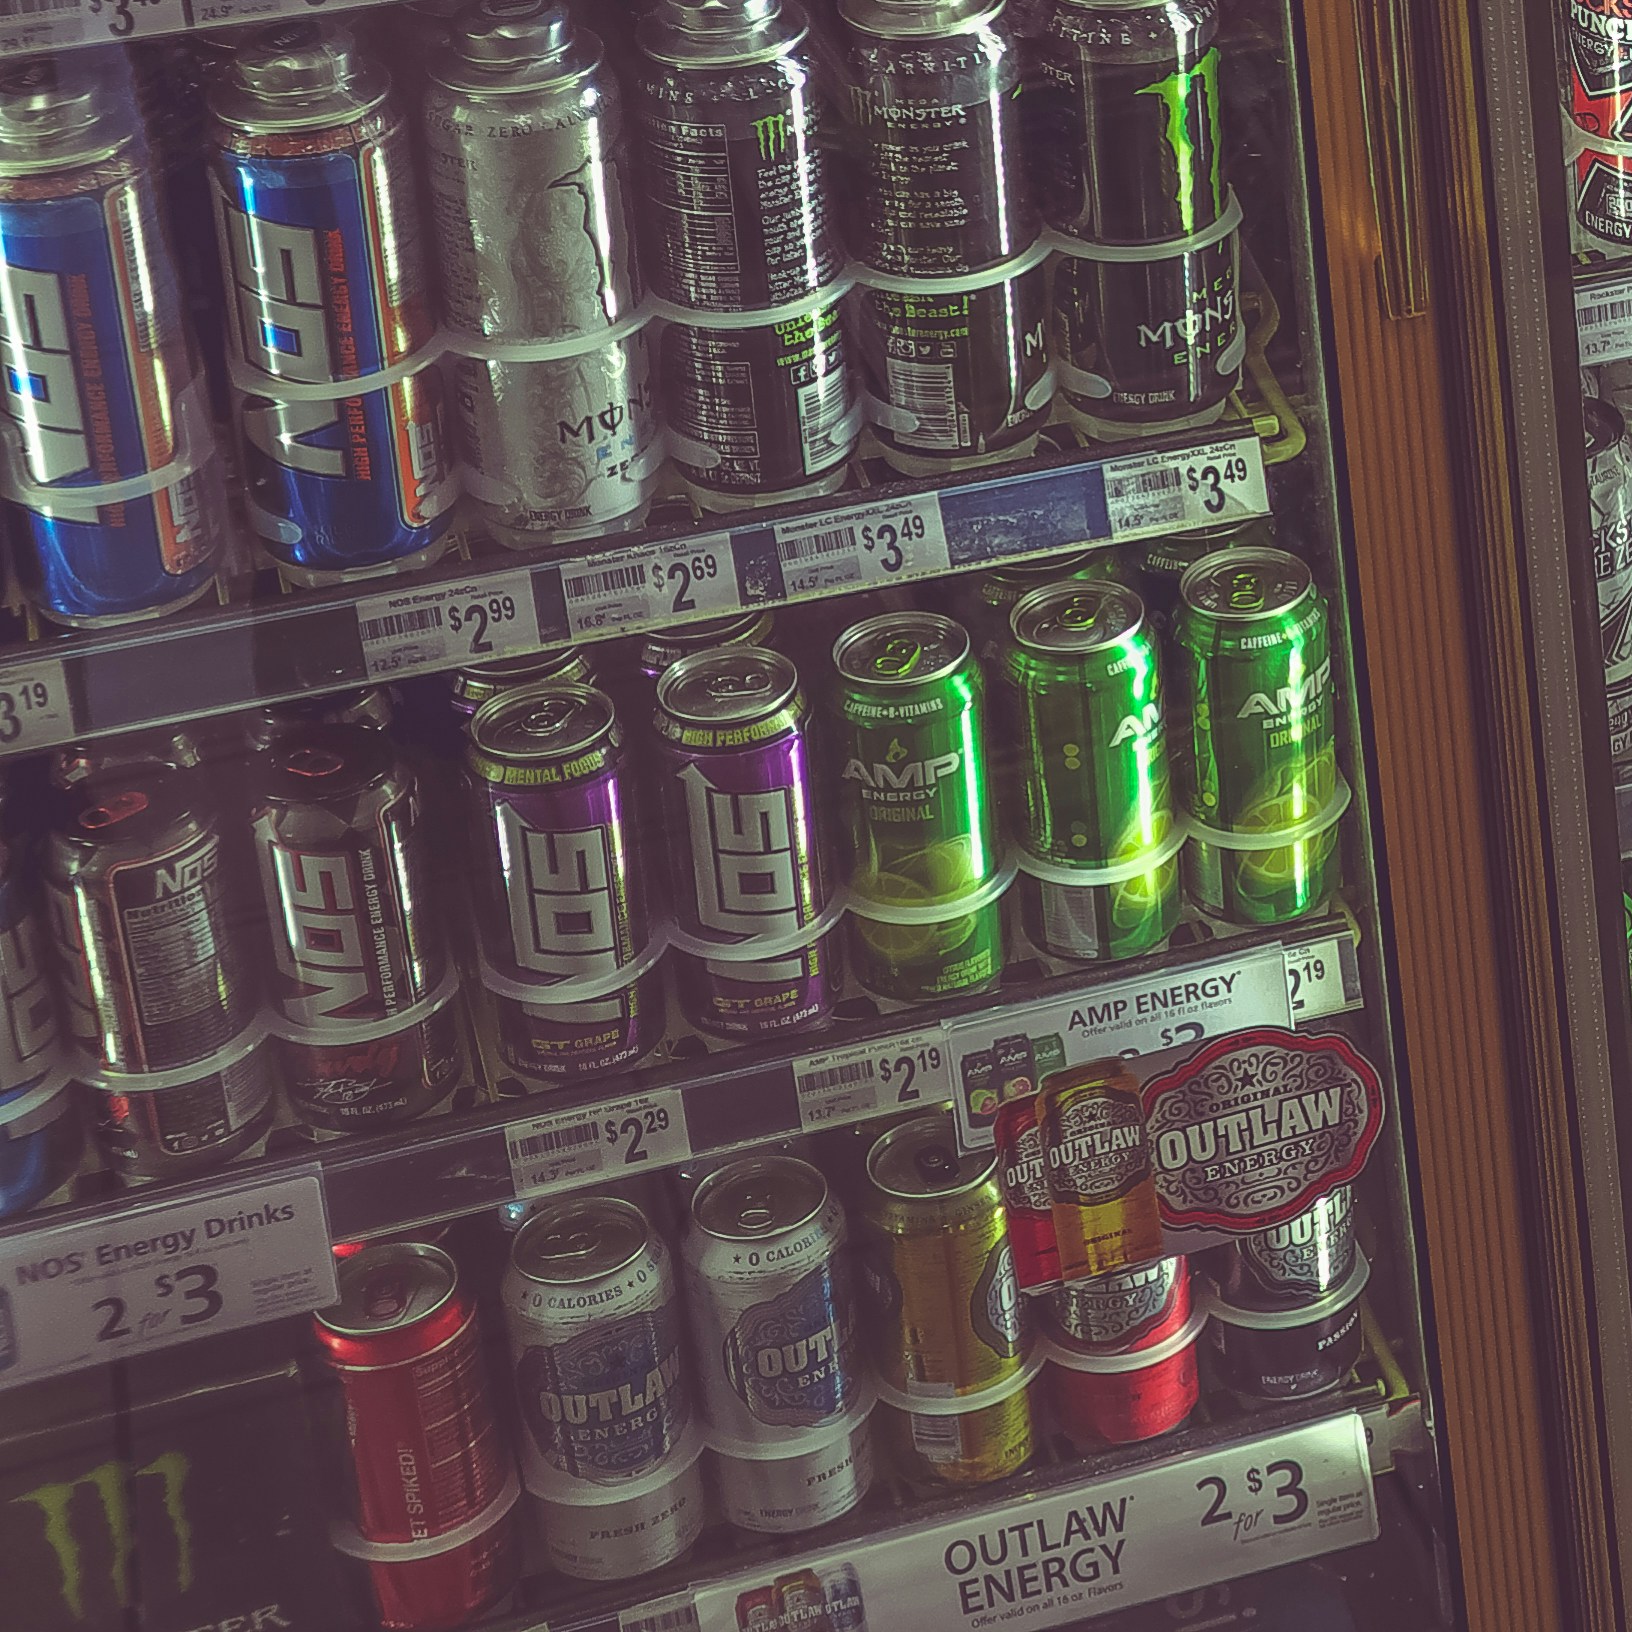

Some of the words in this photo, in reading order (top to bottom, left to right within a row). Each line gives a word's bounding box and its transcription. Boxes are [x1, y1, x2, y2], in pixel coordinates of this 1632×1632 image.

[505, 764, 561, 784] MENTAL
[842, 751, 961, 789] AMP
[862, 784, 938, 800] ENERGY
[868, 799, 935, 823] ORIGINAL
[1068, 1000, 1127, 1031] AMP
[1136, 974, 1236, 1015] ENERGY
[1209, 1085, 1292, 1112] ORIGINAL
[1050, 1124, 1141, 1169] OUTLAW
[1155, 1086, 1344, 1170] OUTLAW
[1204, 1138, 1316, 1183] ENERGY
[15, 1253, 83, 1285] NOS
[95, 1227, 197, 1267] Energy
[205, 1202, 295, 1240] Drinks
[91, 1297, 131, 1343] 2
[154, 1263, 224, 1326] $3
[1196, 1474, 1234, 1528] 2
[1232, 1505, 1264, 1541] for
[944, 1497, 1127, 1575] OUTLAW
[958, 1539, 1126, 1615] ENERGY
